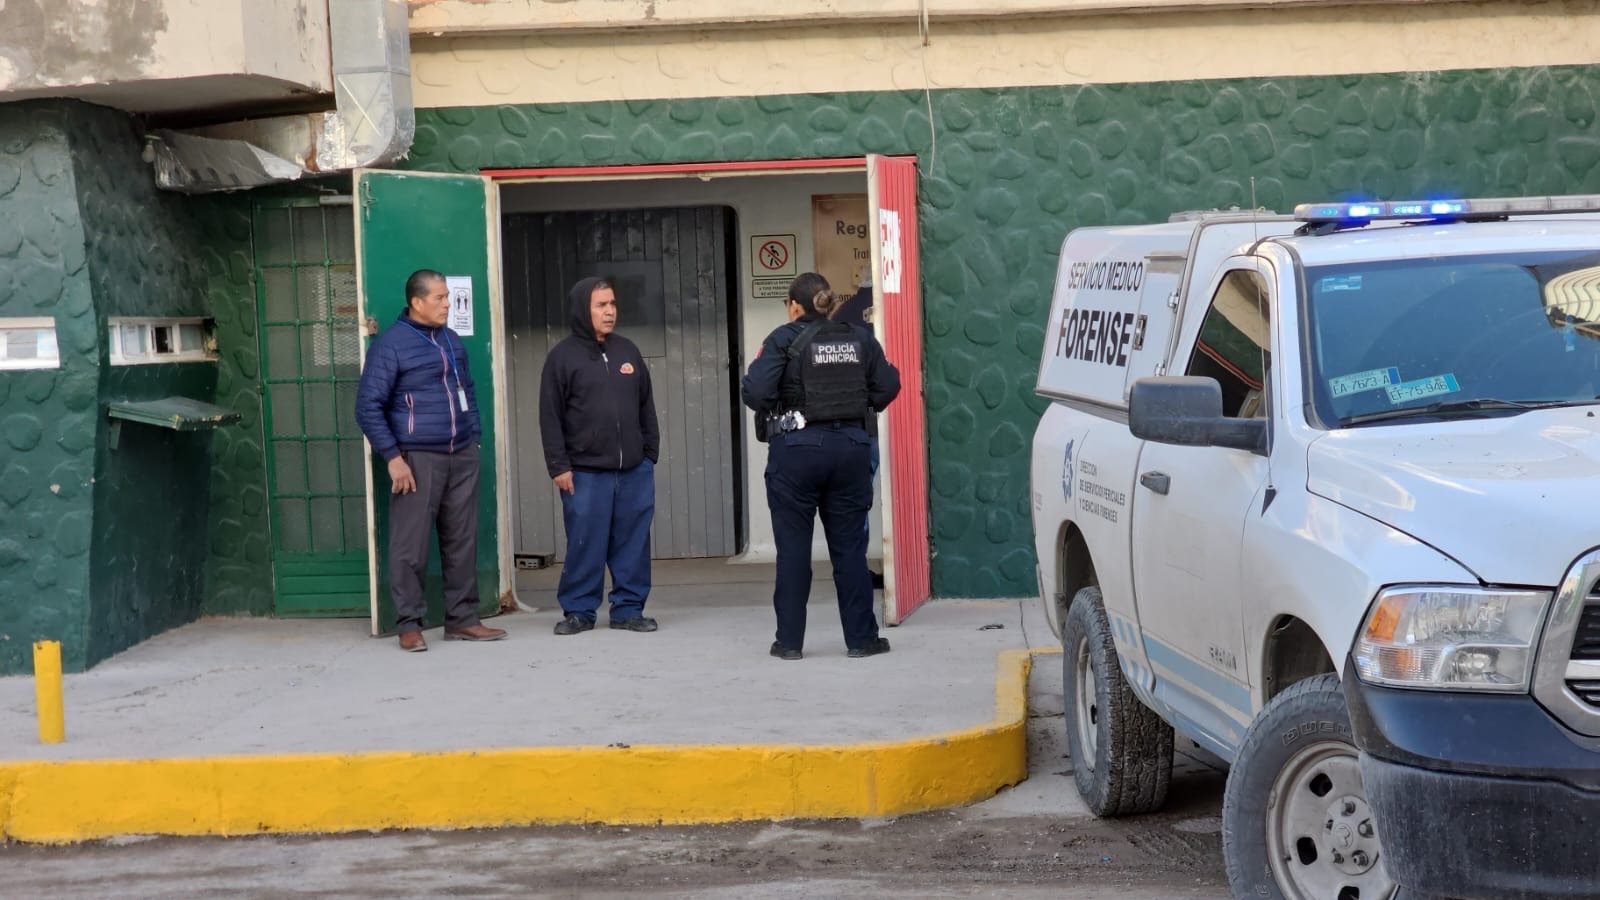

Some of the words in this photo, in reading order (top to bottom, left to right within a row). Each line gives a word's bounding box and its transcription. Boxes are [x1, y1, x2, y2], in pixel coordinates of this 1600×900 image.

[1067, 261, 1107, 290] SERVICIO
[1105, 261, 1144, 292] MEDICO
[818, 342, 856, 354] POLICÍA
[1056, 308, 1134, 367] FORENSE
[815, 353, 860, 364] MUNICIPAL
